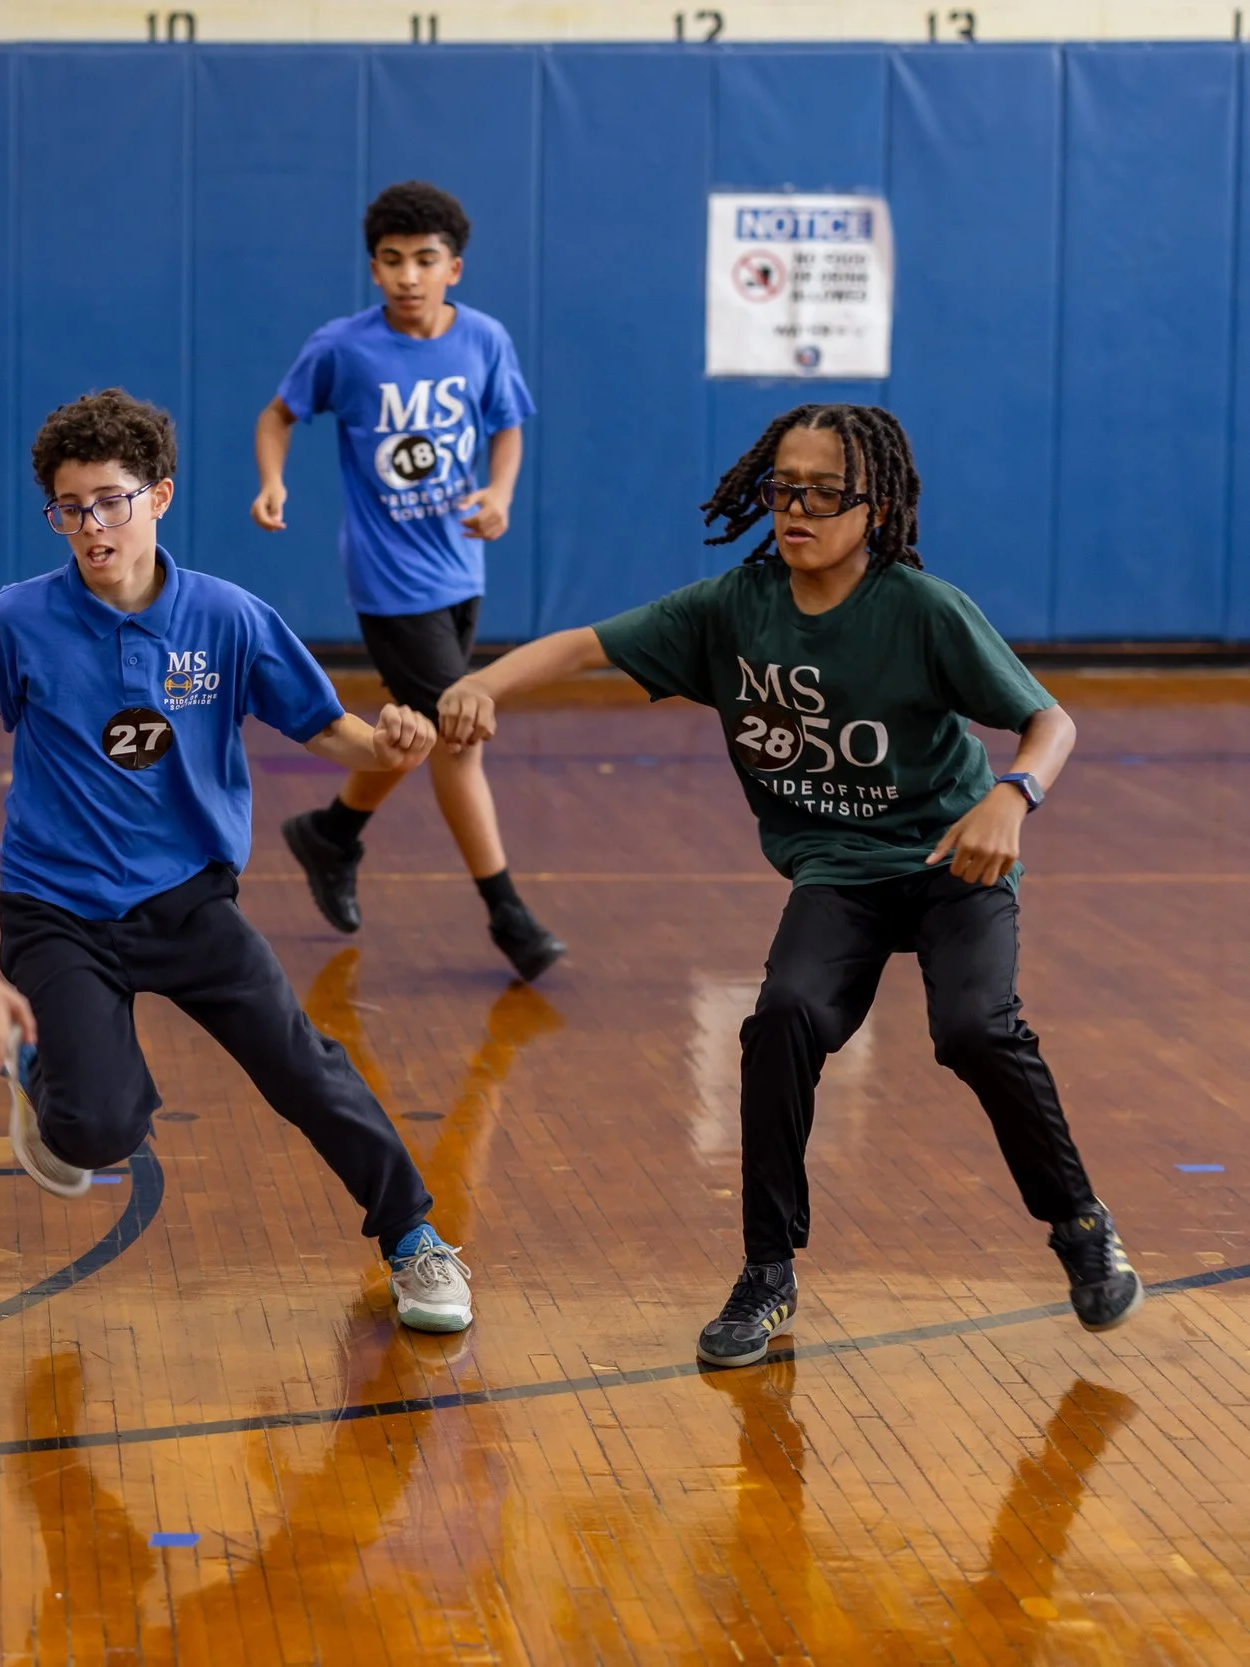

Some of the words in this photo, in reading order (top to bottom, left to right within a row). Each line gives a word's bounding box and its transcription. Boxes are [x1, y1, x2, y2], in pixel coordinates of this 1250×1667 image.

[146, 11, 196, 43] 10
[411, 12, 438, 43] 11
[674, 10, 724, 43] 12
[928, 10, 976, 43] 13
[739, 209, 870, 238] NOTICE
[374, 375, 466, 433] MS
[393, 441, 436, 475] 18
[429, 425, 476, 485] 50
[166, 650, 207, 673] MS
[191, 672, 221, 694] 50
[735, 655, 826, 715] MS
[109, 722, 167, 756] 27
[735, 715, 796, 760] 28
[800, 714, 889, 773] 50
[822, 781, 848, 797] OF
[855, 785, 900, 800] THE
